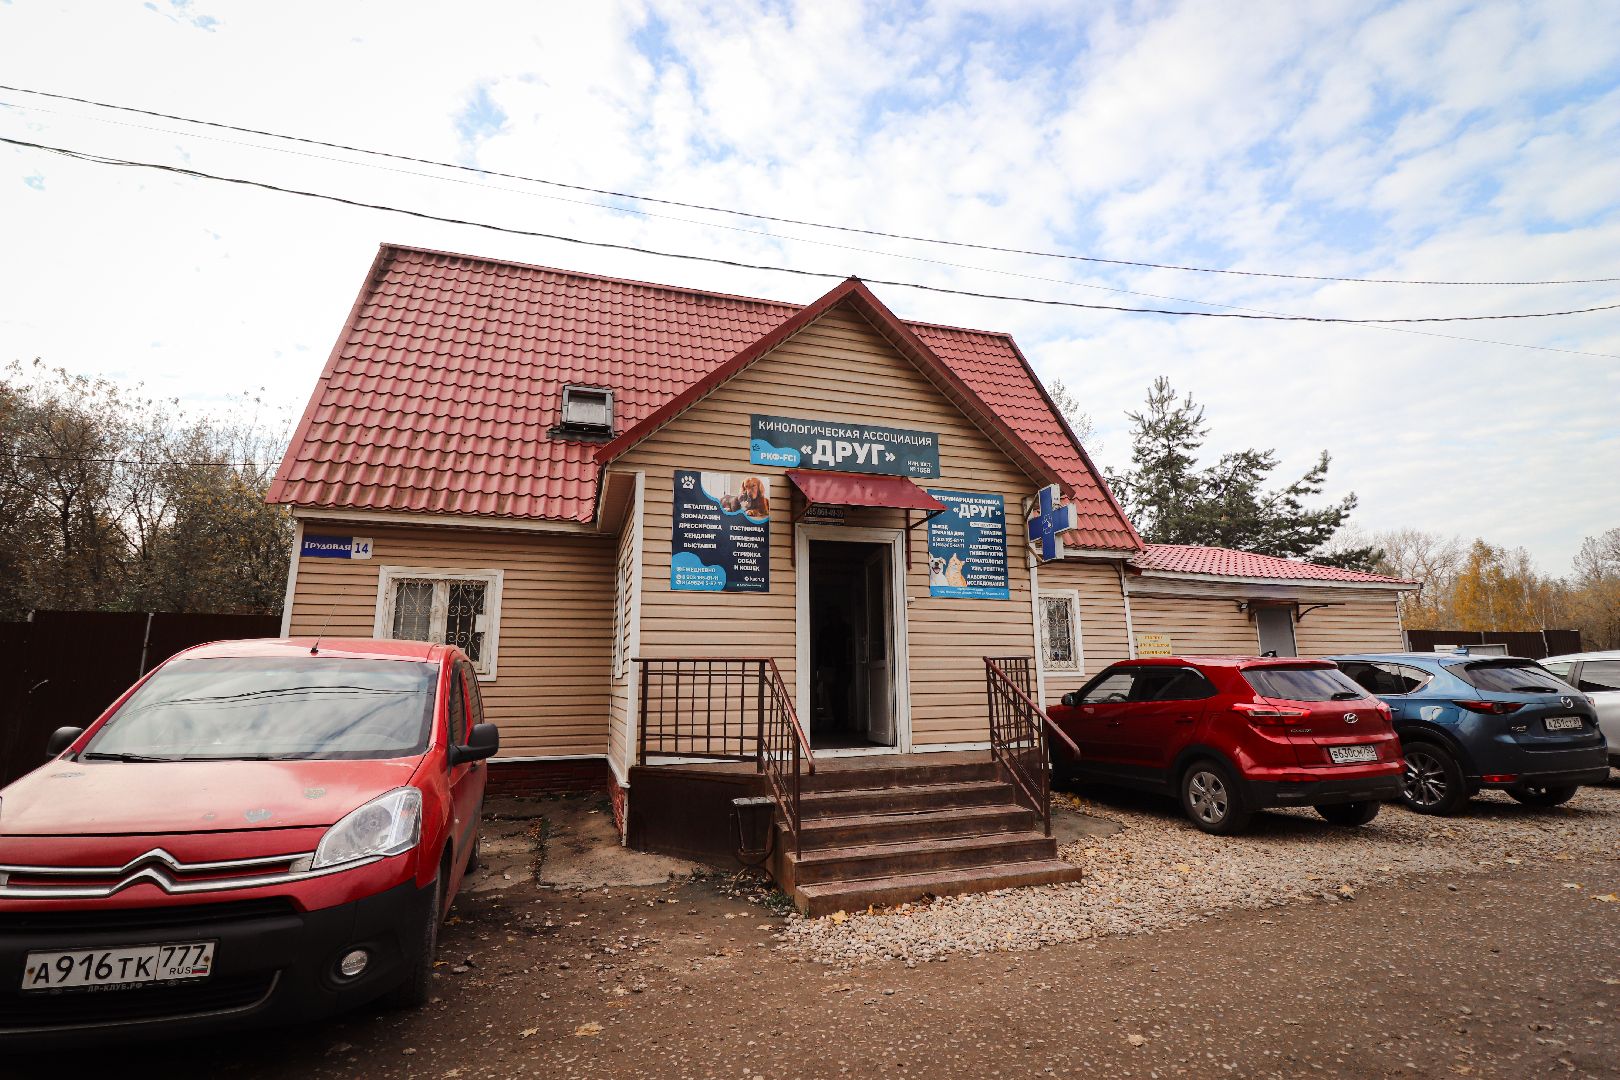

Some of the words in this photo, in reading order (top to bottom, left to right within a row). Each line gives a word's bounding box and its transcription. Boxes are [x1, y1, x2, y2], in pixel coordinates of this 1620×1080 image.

[758, 420, 860, 438] КИНОЛОГИЧЕСКАЯ
[863, 430, 932, 446] АССОЦИАЦИЯ
[760, 452, 796, 462] РКФ-FCI
[800, 439, 896, 466] «ДРУГ»
[953, 504, 1001, 518] «ДРУГ»
[304, 541, 351, 551] ТРУДОВАЯ
[354, 542, 368, 554] 14
[32, 952, 154, 984] А916ТК
[162, 945, 207, 968] 777
[169, 966, 191, 975] RUS
